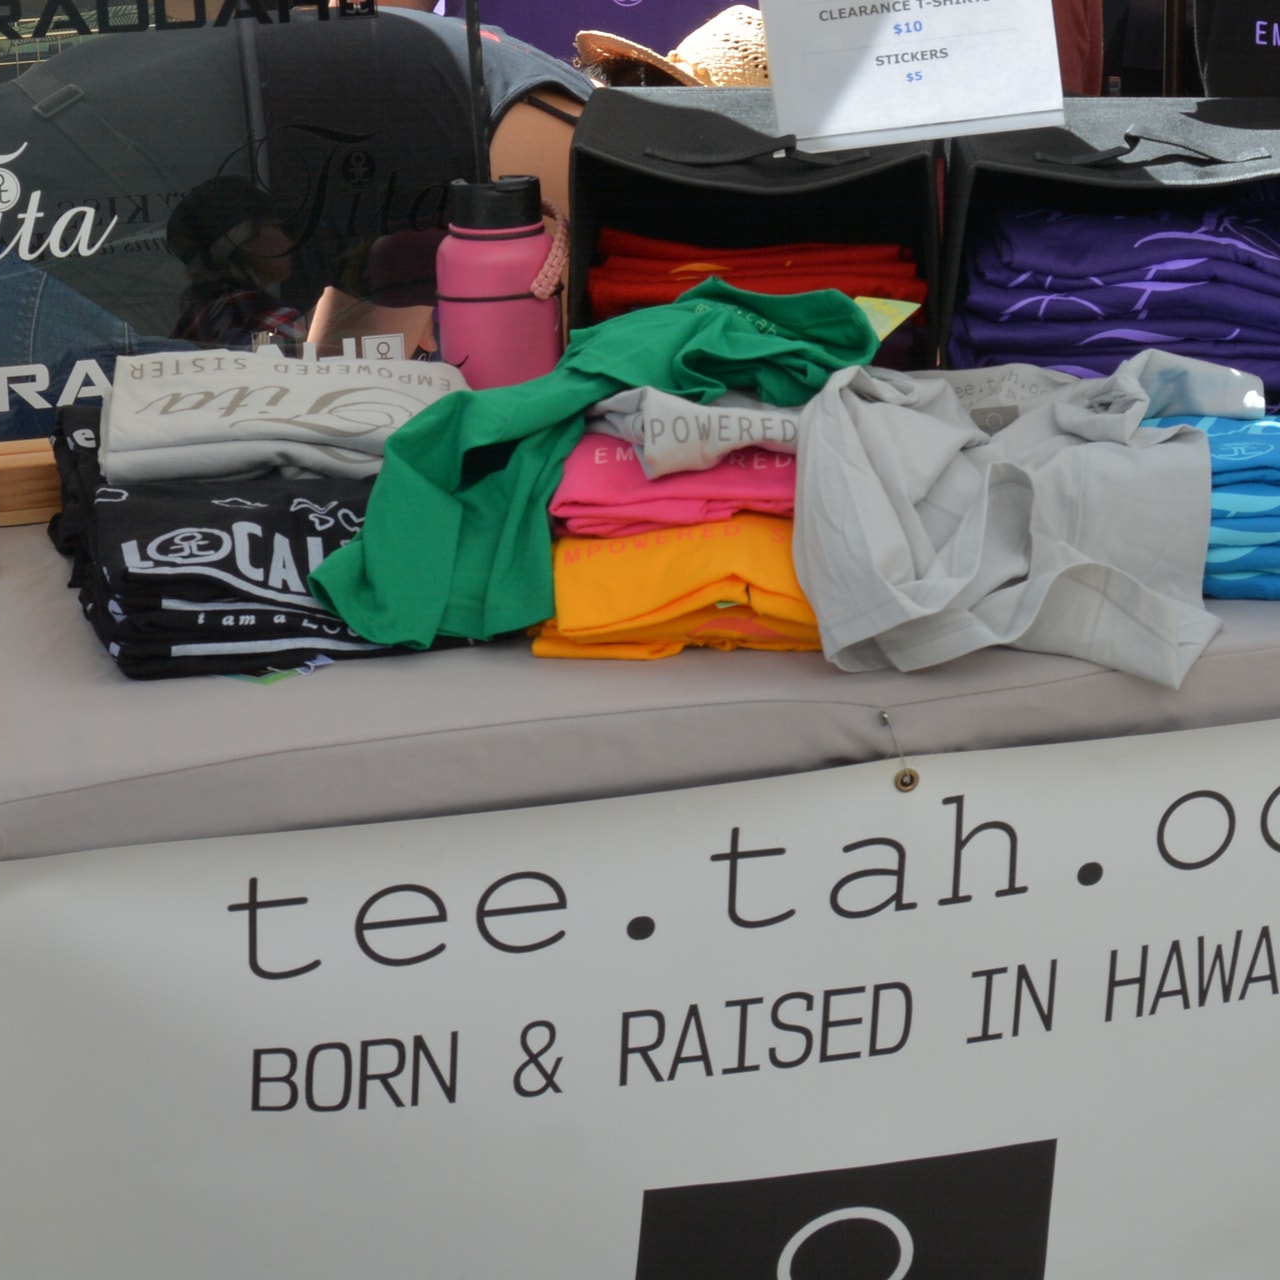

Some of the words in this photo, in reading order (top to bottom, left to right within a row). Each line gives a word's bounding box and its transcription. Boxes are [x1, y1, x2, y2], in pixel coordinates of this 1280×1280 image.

[819, 0, 911, 22] CLEARANCE
[893, 20, 923, 36] $10
[875, 47, 949, 67] STICKERS
[905, 71, 923, 83] $5
[130, 356, 247, 380] SISTER
[273, 360, 452, 391] EMPOWERED
[651, 416, 797, 445] POWERED
[563, 523, 741, 565] MPOWERED
[250, 1030, 460, 1114] BORN
[511, 1020, 565, 1099] &
[617, 980, 913, 1089] RAISED
[966, 958, 1058, 1046] IN
